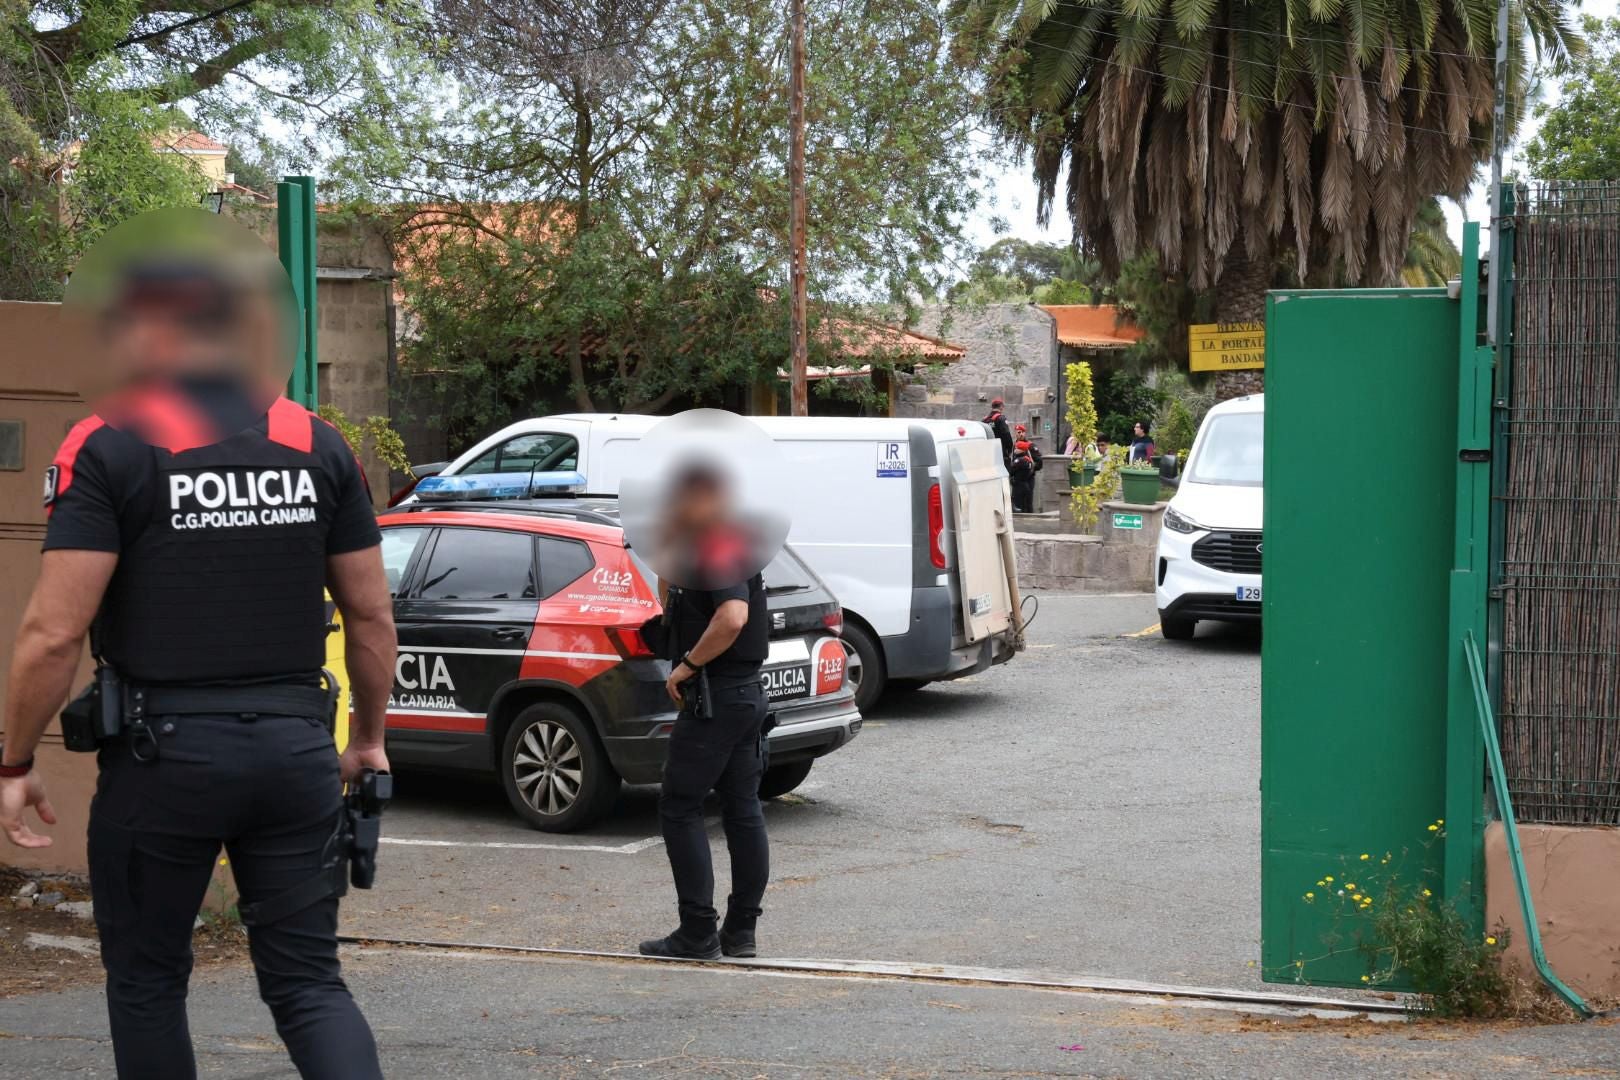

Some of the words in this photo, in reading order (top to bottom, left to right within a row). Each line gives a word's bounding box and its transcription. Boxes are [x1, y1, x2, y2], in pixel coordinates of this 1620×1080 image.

[1201, 340, 1215, 350] LA
[886, 443, 899, 460] IR
[879, 461, 906, 469] 11-2026
[169, 469, 318, 510] POLICIA
[260, 507, 316, 525] CANARIA
[1245, 588, 1260, 599] 29
[784, 686, 806, 695] CANARIA
[400, 693, 456, 709] CANARIA
